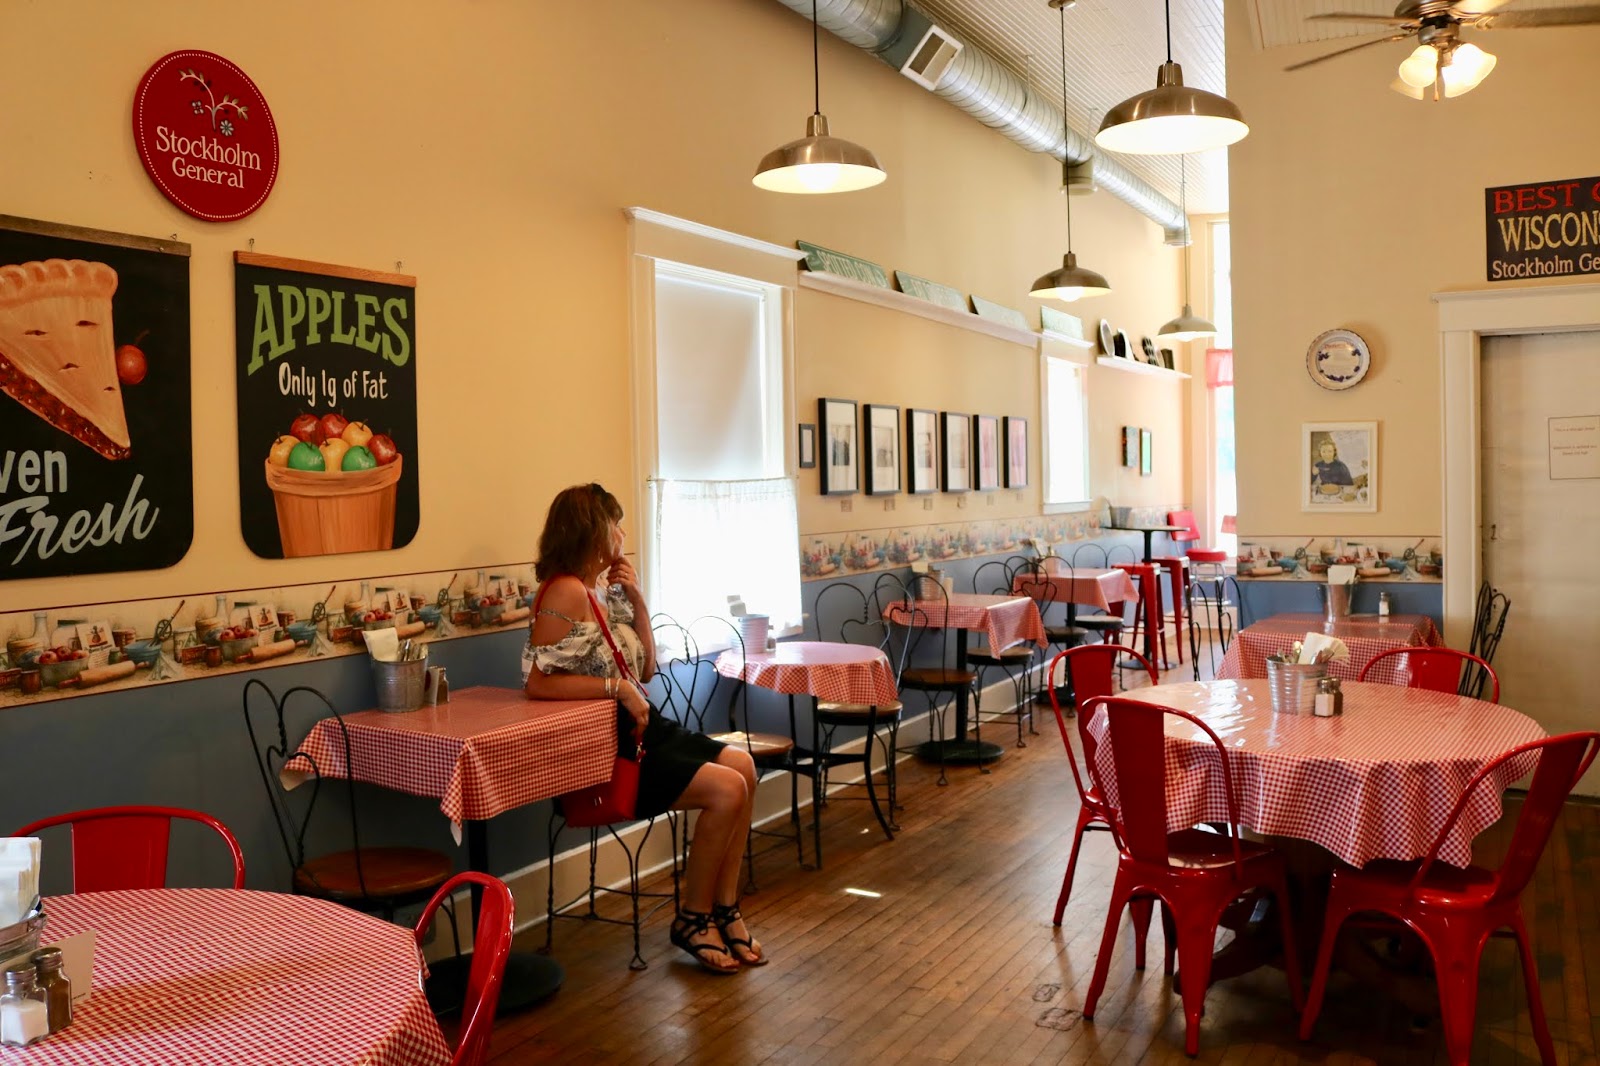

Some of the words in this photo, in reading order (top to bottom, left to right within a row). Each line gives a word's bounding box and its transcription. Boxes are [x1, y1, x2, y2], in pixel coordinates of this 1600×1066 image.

[156, 125, 262, 171] Stockholm
[172, 156, 245, 189] General
[1494, 183, 1580, 214] BEST
[1498, 210, 1600, 252] WISCON
[1492, 254, 1574, 279] Stockholm
[247, 284, 410, 376] APPLES
[278, 361, 316, 407] Only
[343, 370, 358, 398] of
[362, 370, 389, 399] Fat
[0, 473, 160, 566] Fresh
